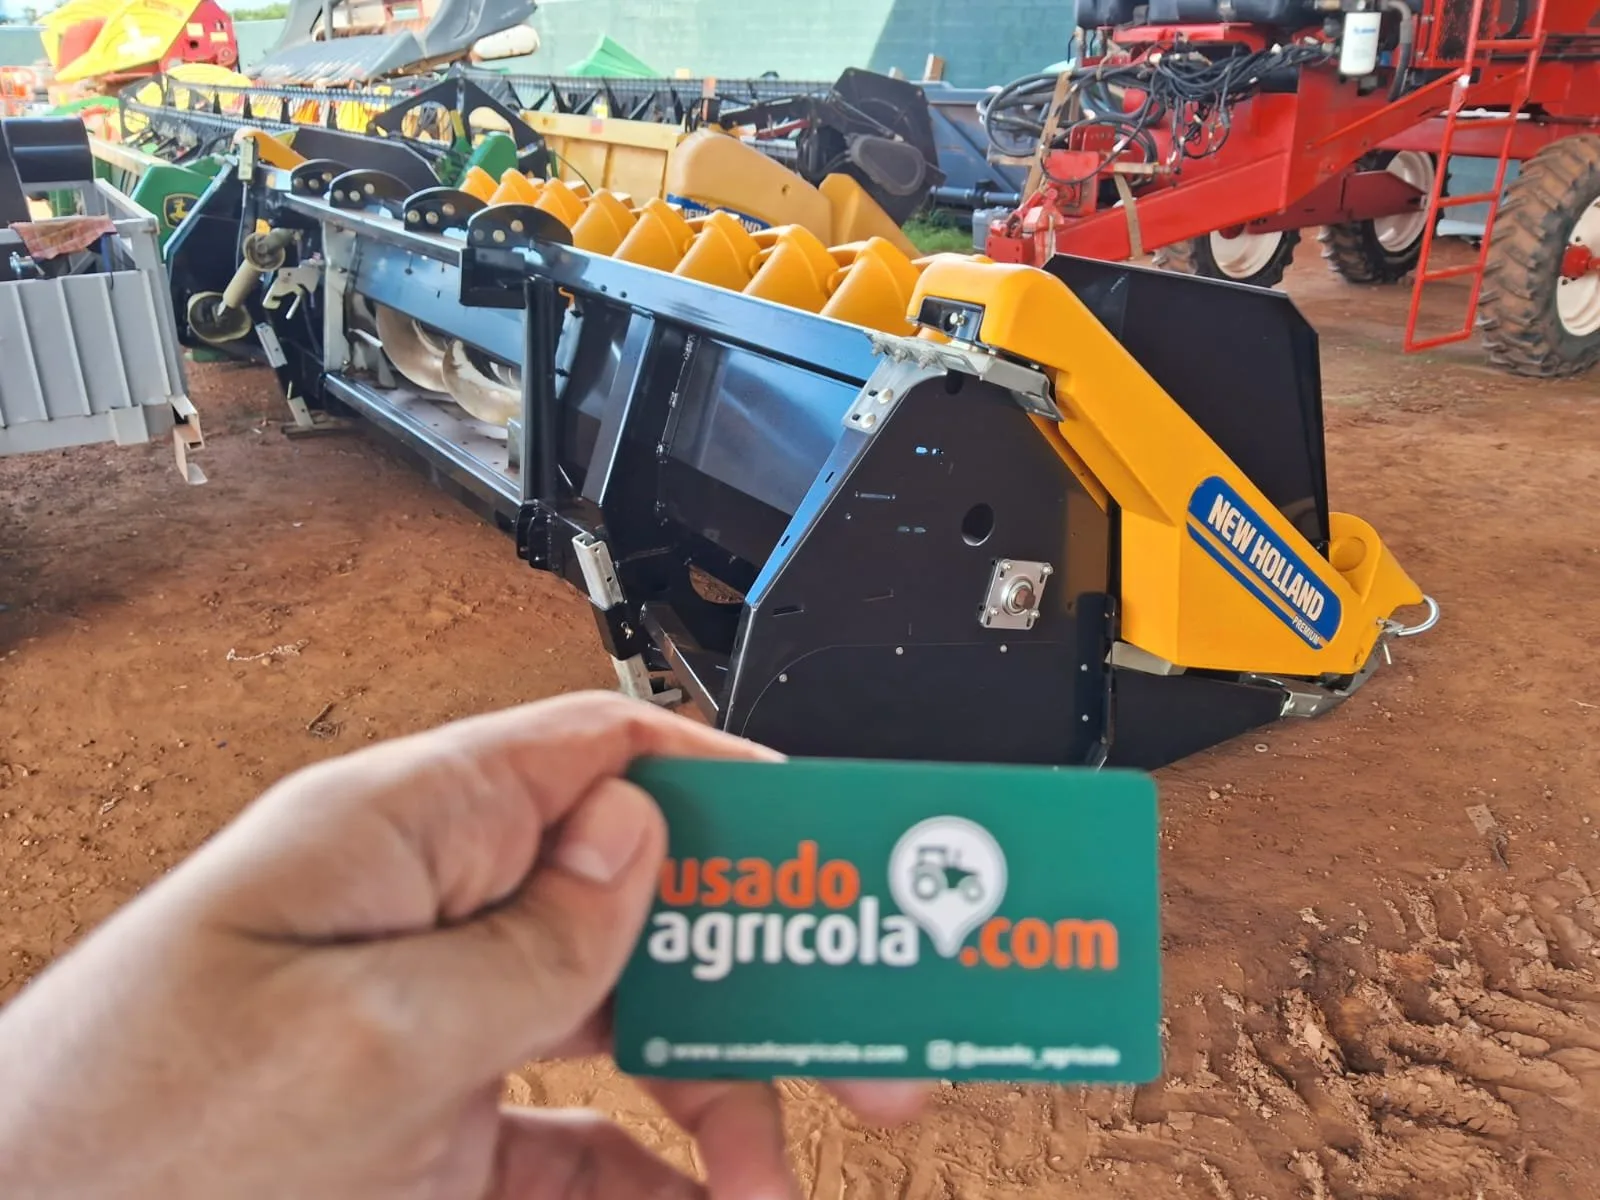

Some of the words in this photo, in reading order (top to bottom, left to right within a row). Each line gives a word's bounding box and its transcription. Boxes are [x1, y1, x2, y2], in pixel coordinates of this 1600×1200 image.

[1207, 493, 1257, 554] NEW
[1249, 534, 1324, 621] HOLLAND
[1292, 616, 1320, 645] PREMIUM
[660, 840, 860, 910] usado
[648, 895, 919, 981] agricola
[960, 916, 1119, 971] .com
